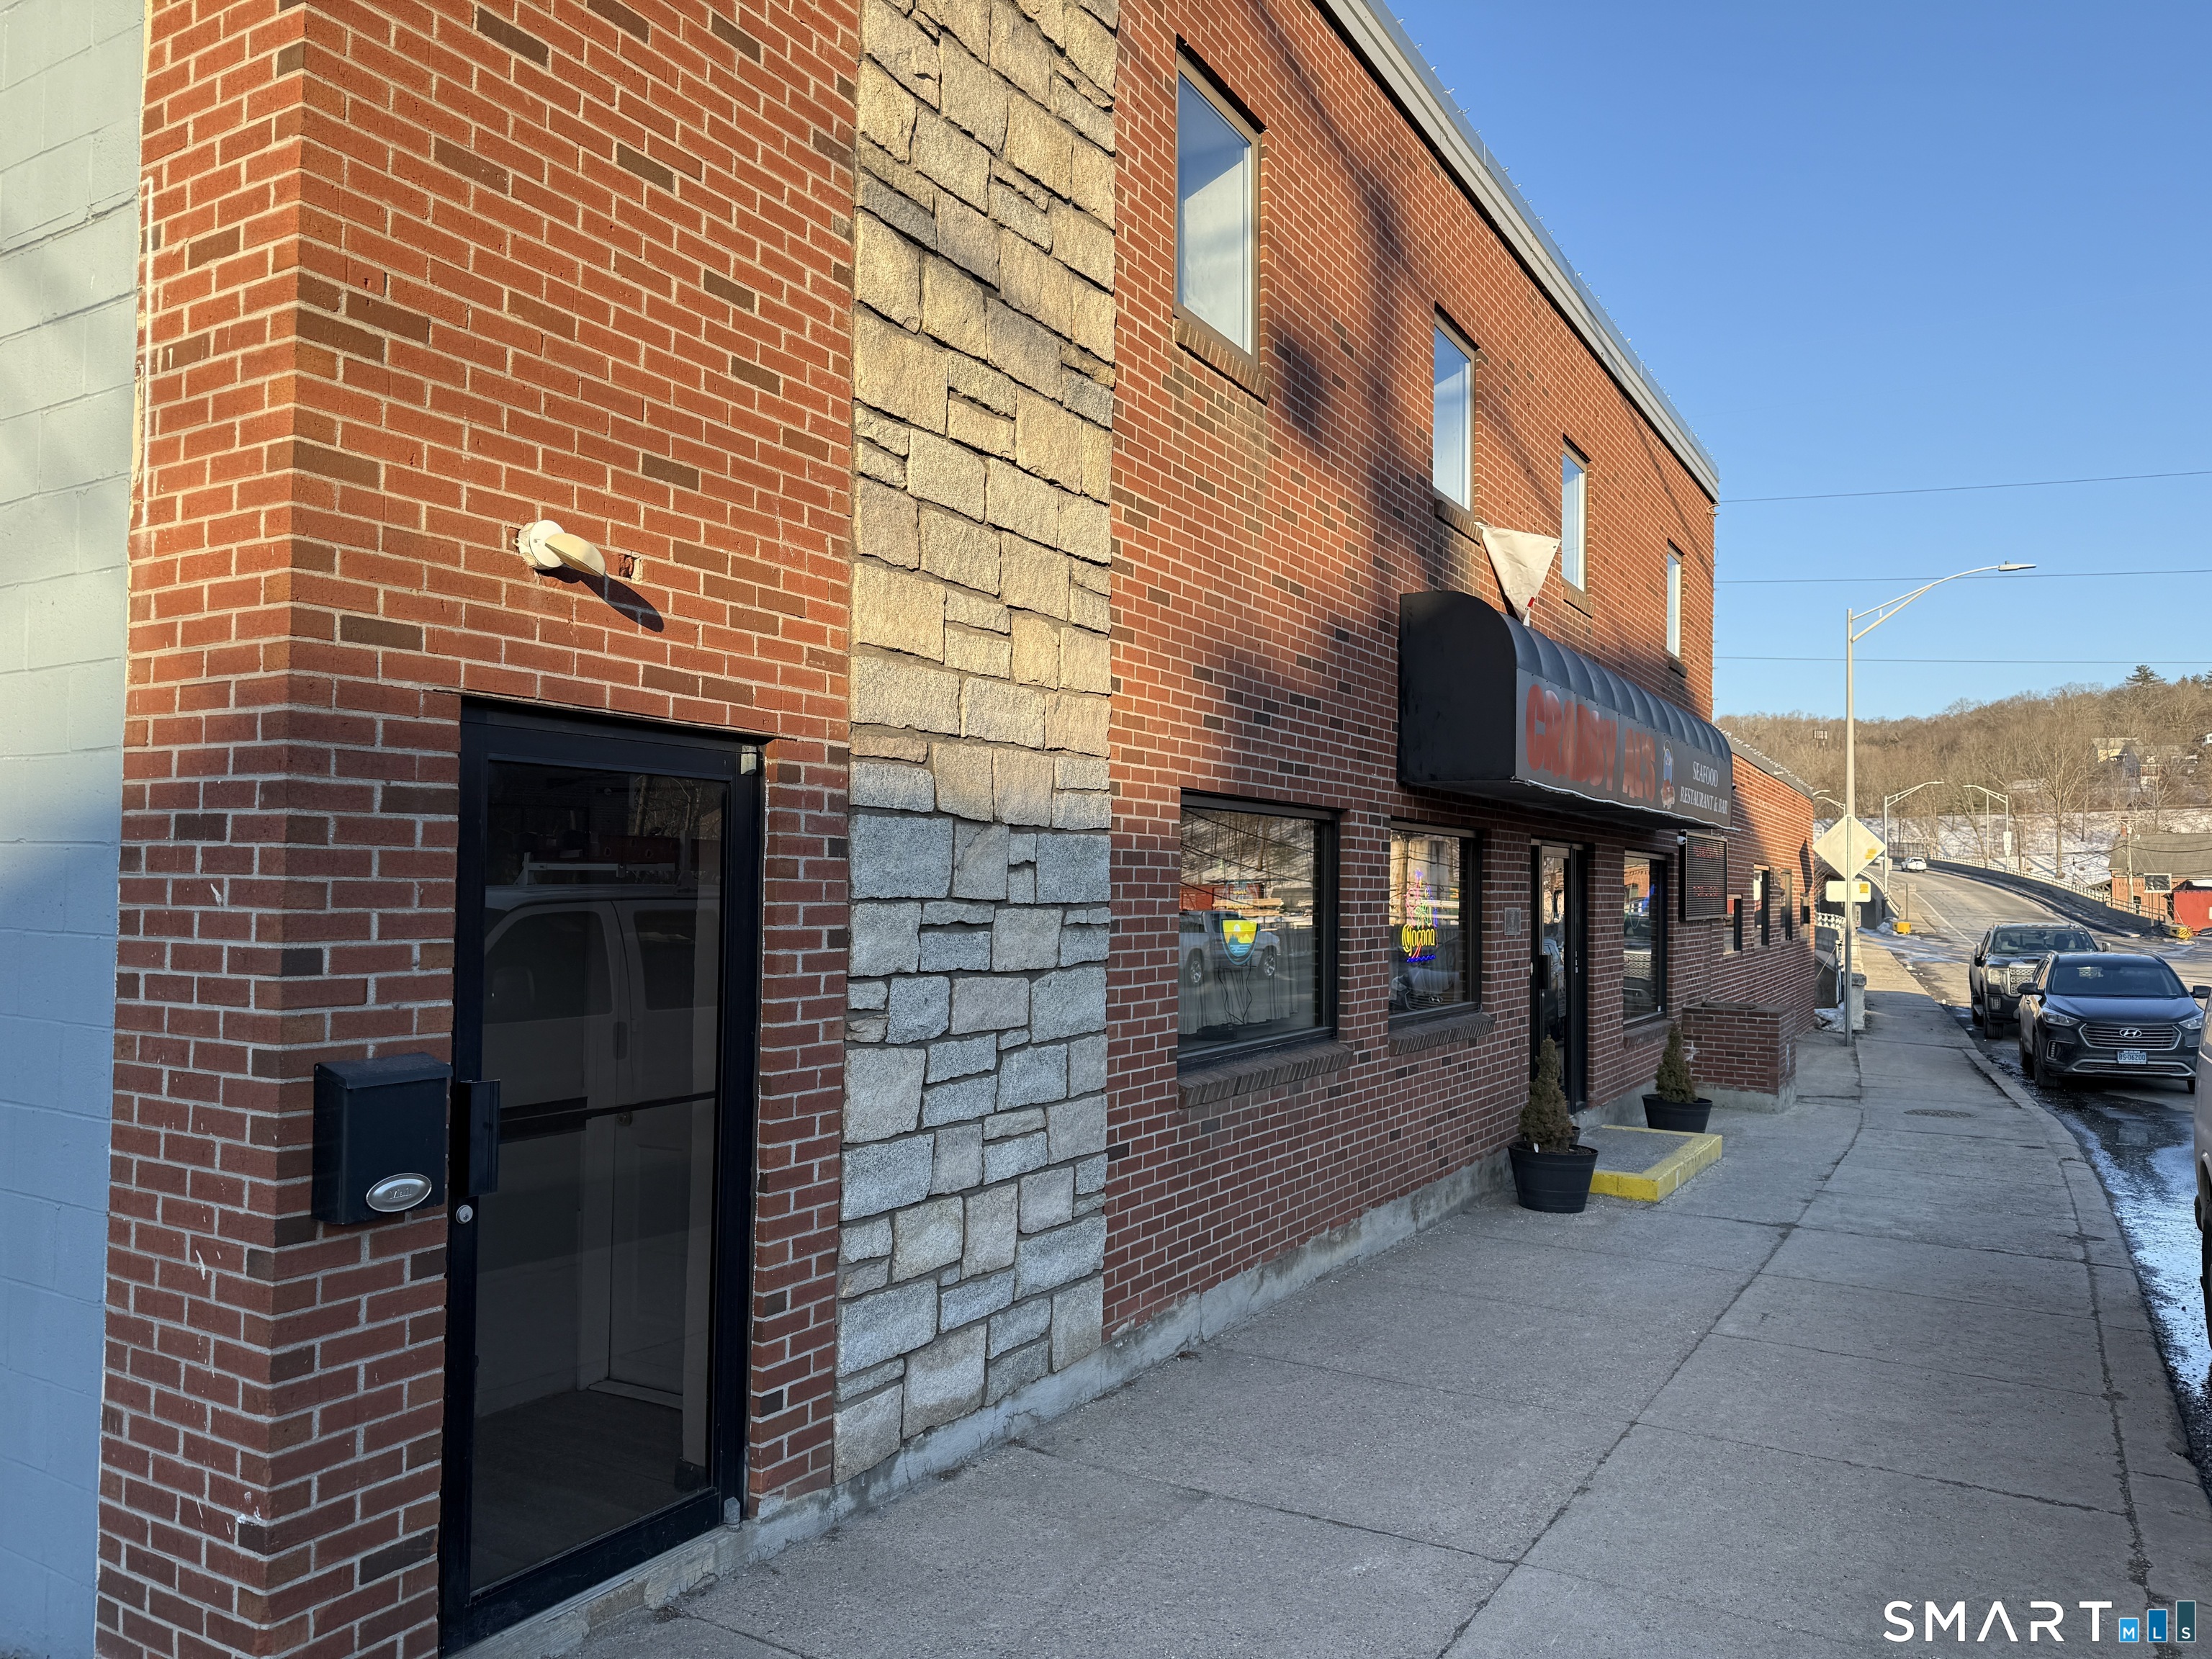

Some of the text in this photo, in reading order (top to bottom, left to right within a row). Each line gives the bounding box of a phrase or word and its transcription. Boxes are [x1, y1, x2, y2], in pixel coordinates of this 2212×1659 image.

[1693, 760, 1719, 788] SEAFOOD
[1680, 786, 1728, 815] RESTAURANT & BAR
[1401, 924, 1435, 957] Corona
[389, 1186, 412, 1200] Mail
